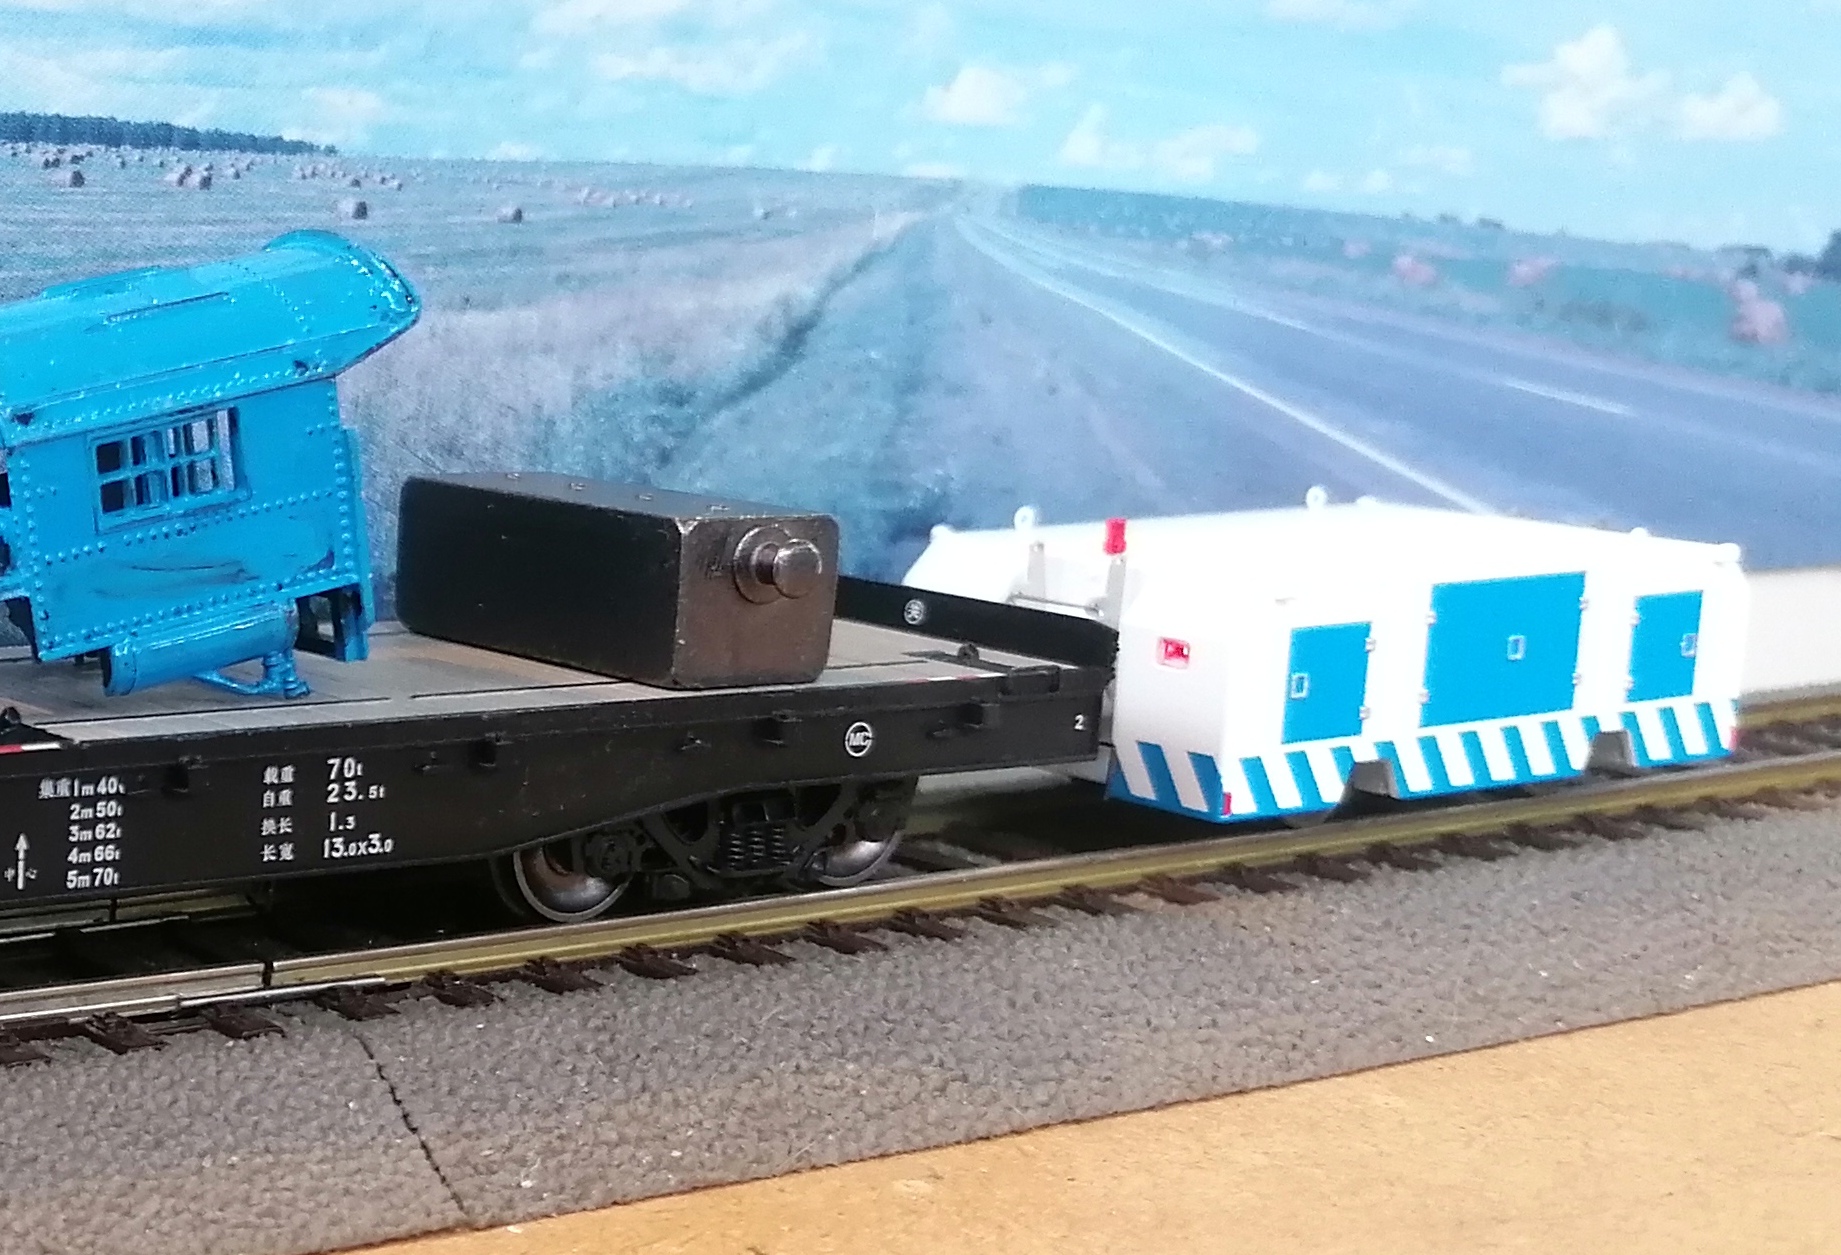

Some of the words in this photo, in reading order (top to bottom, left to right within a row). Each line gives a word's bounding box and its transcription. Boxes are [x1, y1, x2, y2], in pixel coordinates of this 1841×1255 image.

[1074, 714, 1084, 731] 2
[326, 757, 363, 780] 70t
[262, 788, 294, 808] 自重
[329, 811, 356, 832] 1.3
